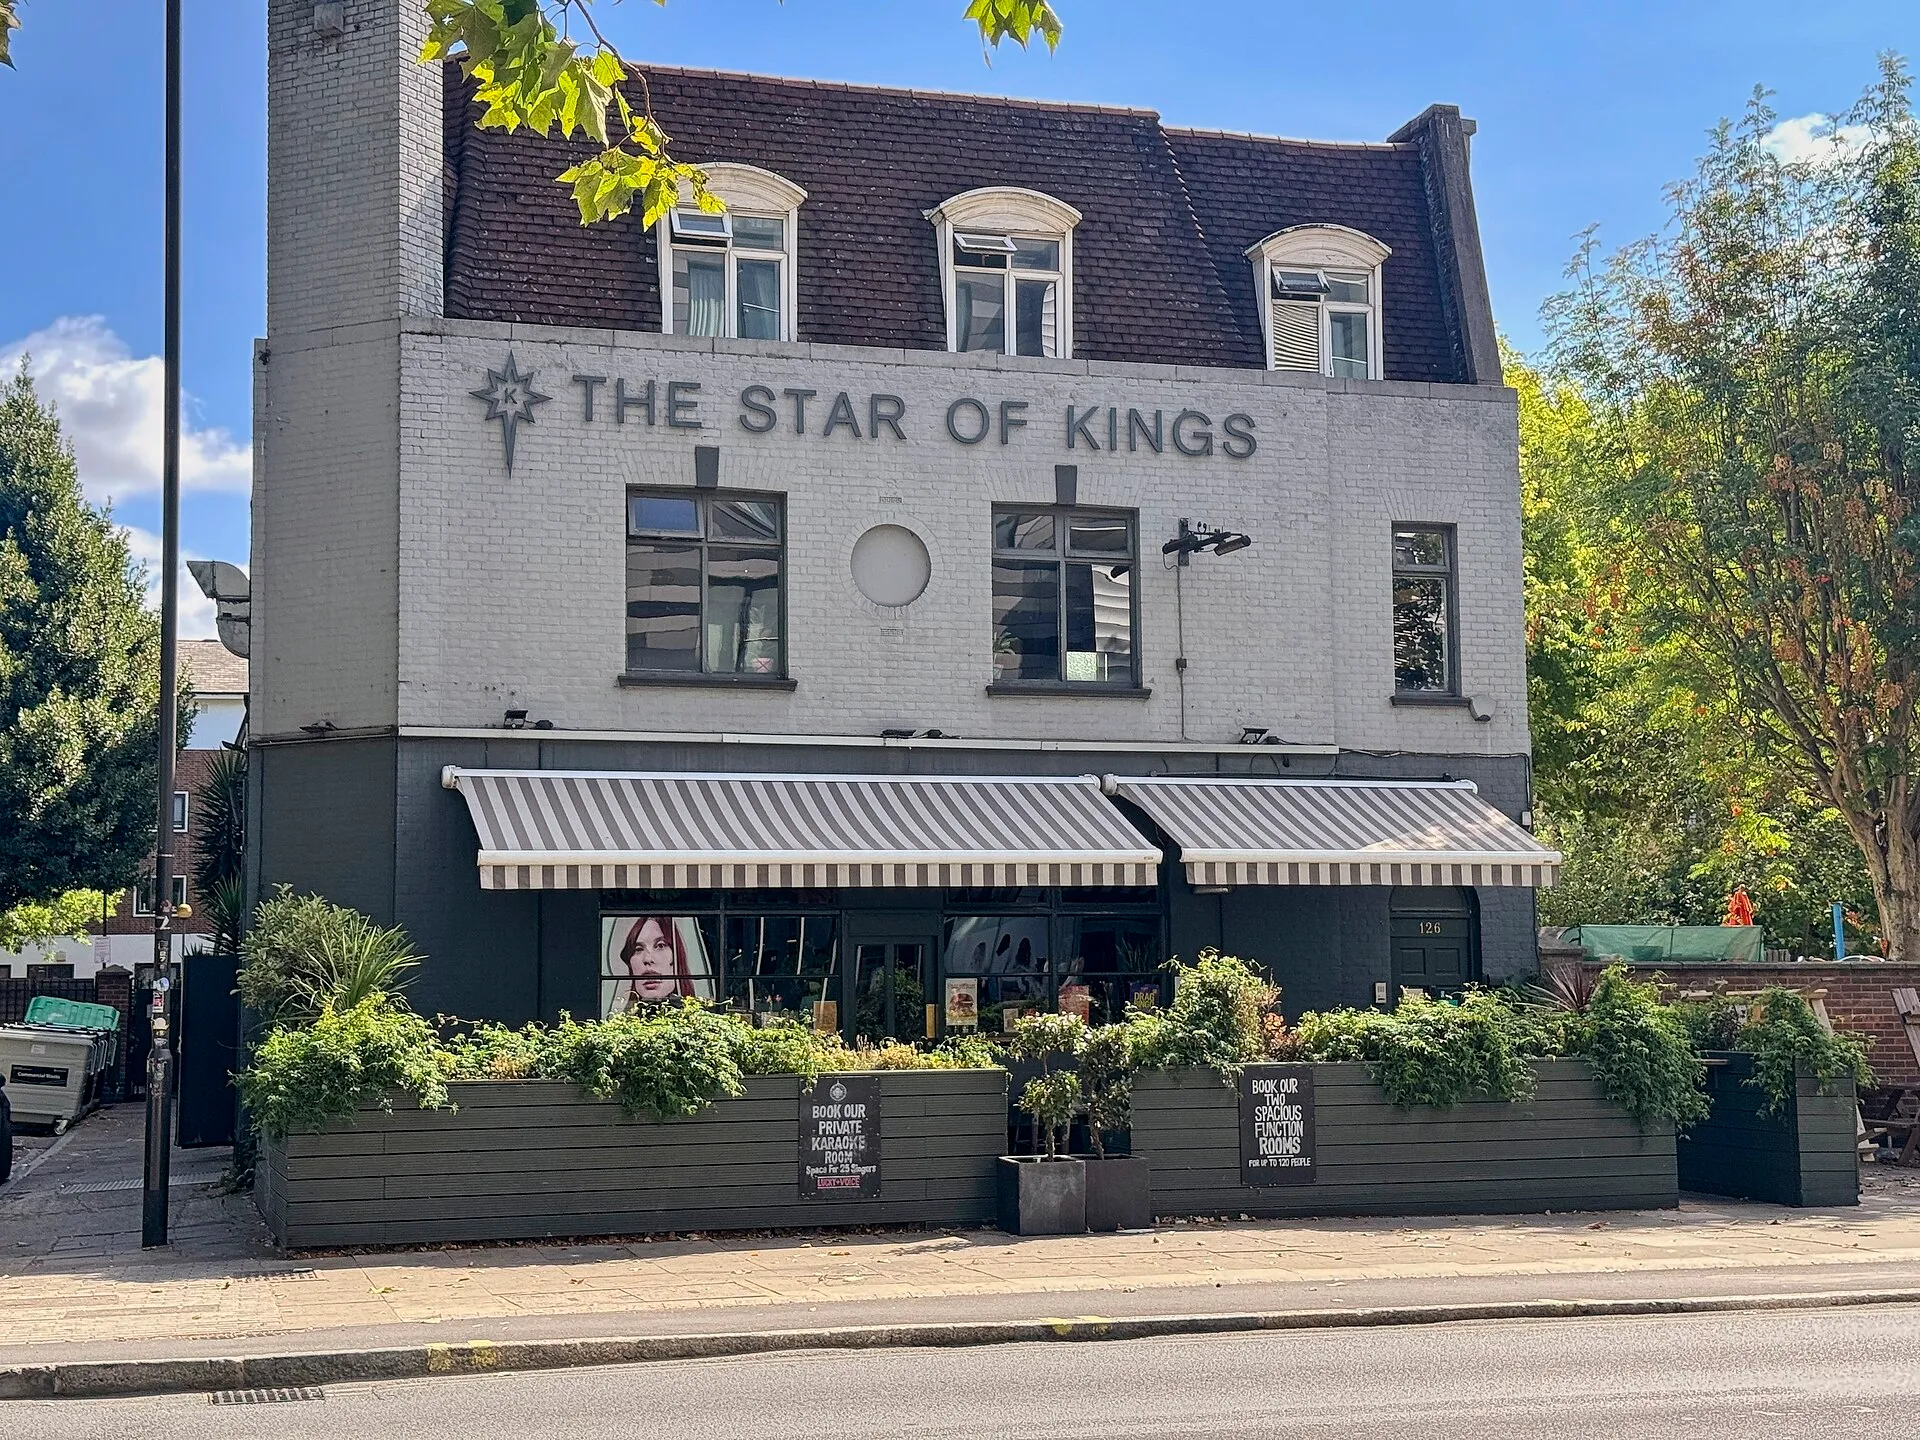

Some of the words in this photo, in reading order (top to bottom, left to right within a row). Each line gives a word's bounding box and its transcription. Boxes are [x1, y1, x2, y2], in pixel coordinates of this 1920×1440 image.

[504, 387, 518, 405] K
[573, 374, 702, 429] THE
[740, 384, 907, 441] STAR
[946, 397, 1029, 445] OF
[1067, 404, 1258, 459] KINGS
[1420, 921, 1440, 934] 126
[1134, 992, 1155, 1001] DRAG
[1252, 1079, 1278, 1094] BOOK
[1280, 1078, 1298, 1093] OUR
[1264, 1093, 1285, 1106] TWO
[812, 1104, 841, 1119] BOOK
[844, 1104, 866, 1118] OUR
[1255, 1105, 1302, 1121] SPACIOUS
[819, 1120, 862, 1134] PRIVATE
[1255, 1121, 1303, 1138] FUNCTION
[811, 1135, 866, 1150] KARAOKE
[1259, 1137, 1301, 1155] ROOMS
[825, 1151, 853, 1164] ROOM
[1249, 1159, 1260, 1167] FOR
[1261, 1159, 1268, 1167] UP
[1269, 1159, 1277, 1167] TO
[1279, 1158, 1289, 1167] 120
[1291, 1158, 1311, 1167] PEOPLE
[806, 1165, 827, 1176] Space
[840, 1164, 850, 1173] 25
[851, 1164, 876, 1175] Singers
